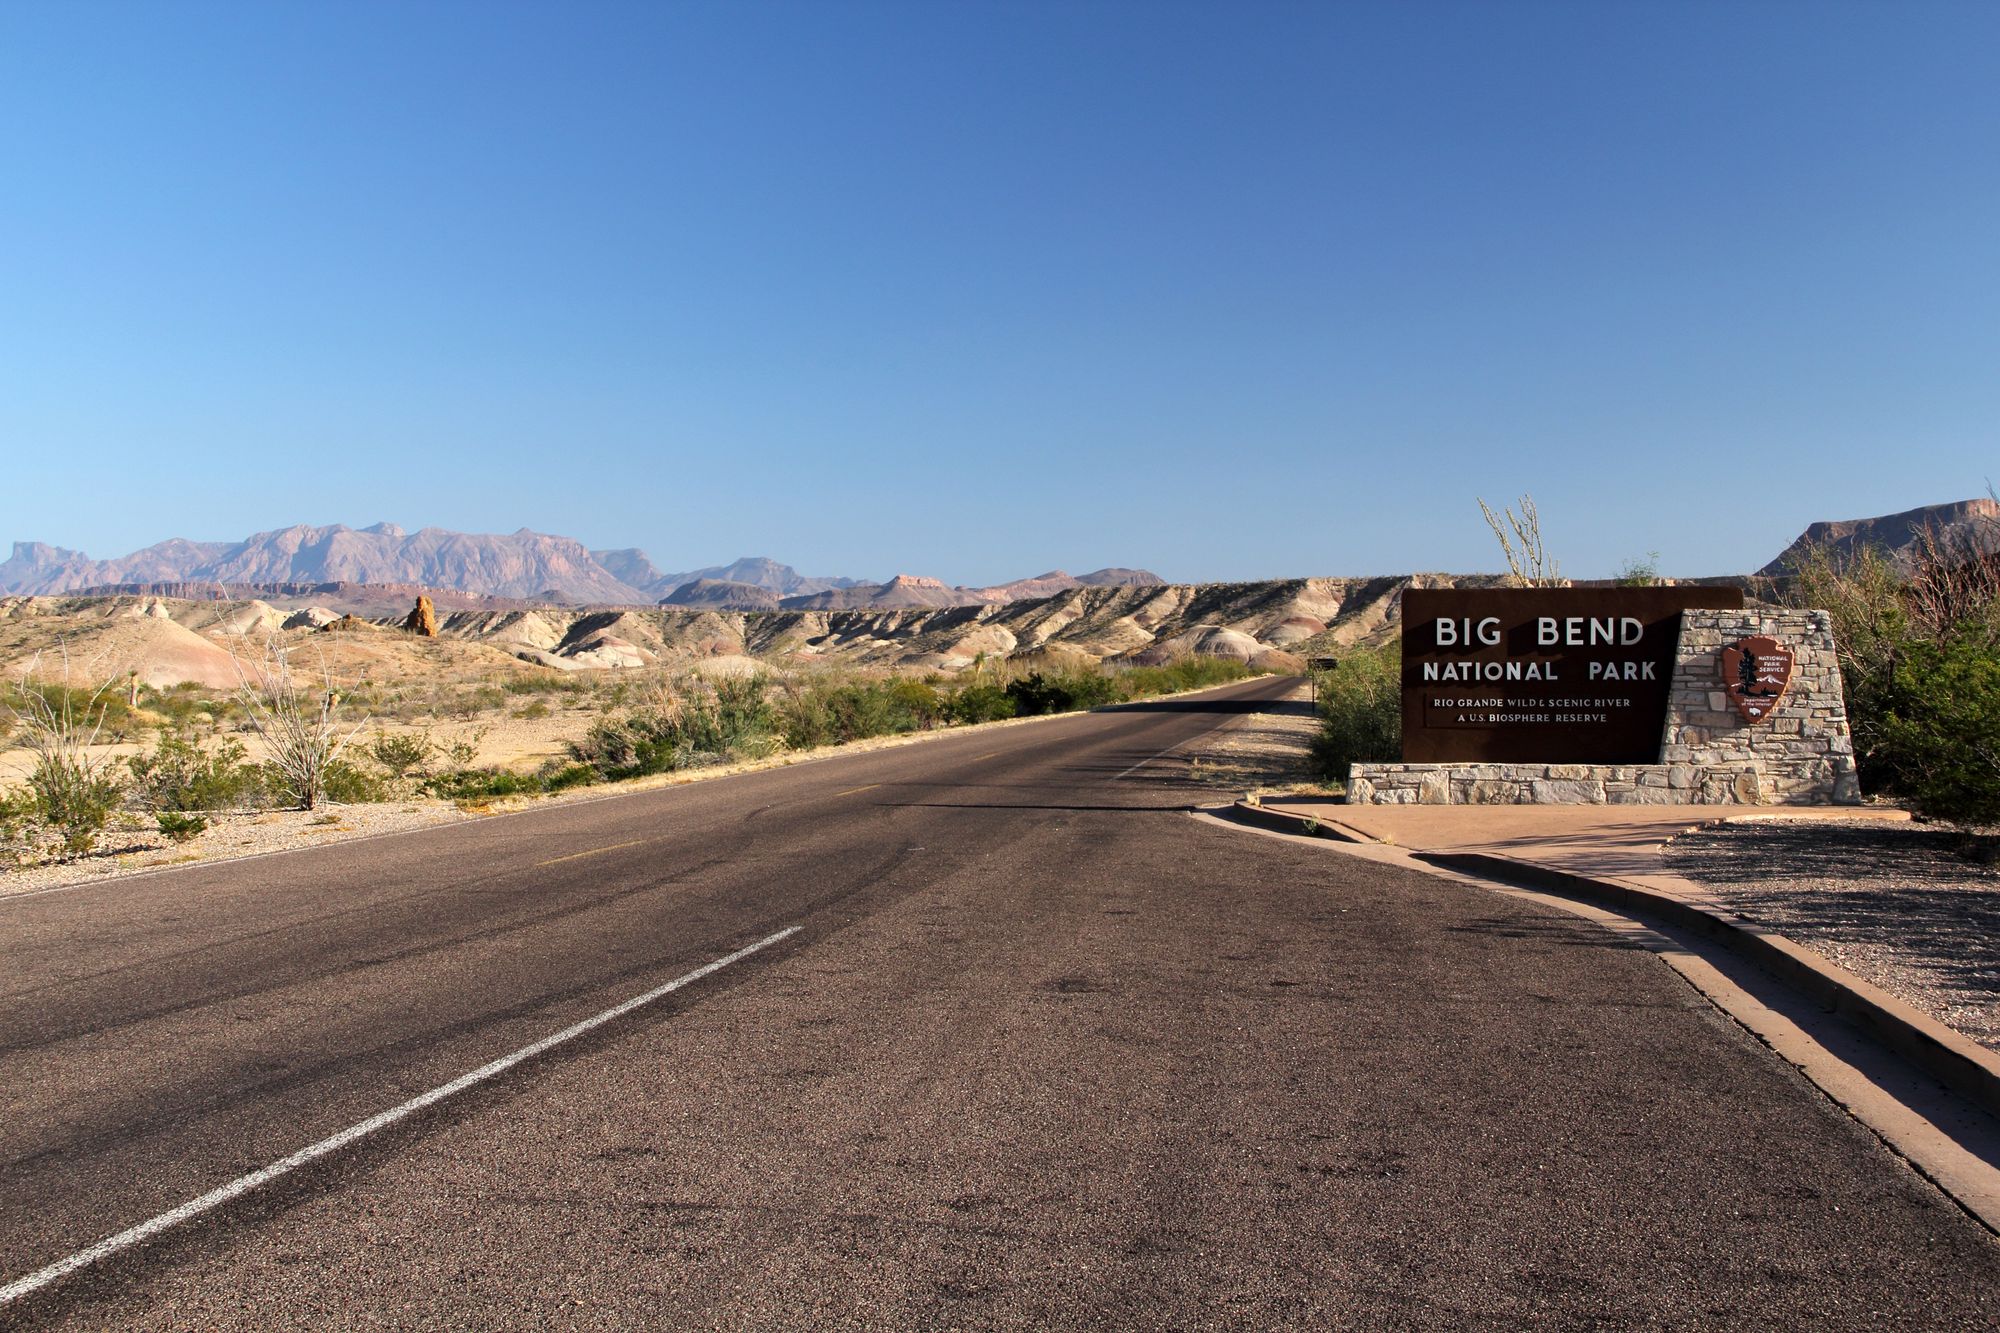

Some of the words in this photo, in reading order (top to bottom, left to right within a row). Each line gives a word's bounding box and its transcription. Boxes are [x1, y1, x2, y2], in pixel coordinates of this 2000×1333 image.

[1437, 617, 1501, 645] BIG
[1538, 617, 1643, 645] BEND
[1424, 661, 1558, 680] NATIONAL
[1589, 661, 1656, 680] PARK
[1434, 699, 1454, 707] RIO
[1457, 699, 1504, 707] GRANDE
[1507, 699, 1536, 707] WILD
[1548, 699, 1591, 707] SCENIC
[1594, 699, 1630, 707] RIVER
[1458, 714, 1466, 722] A
[1469, 714, 1486, 722] U.S.
[1489, 714, 1550, 722] BIOSPHERE
[1555, 714, 1607, 722] RESERVE
